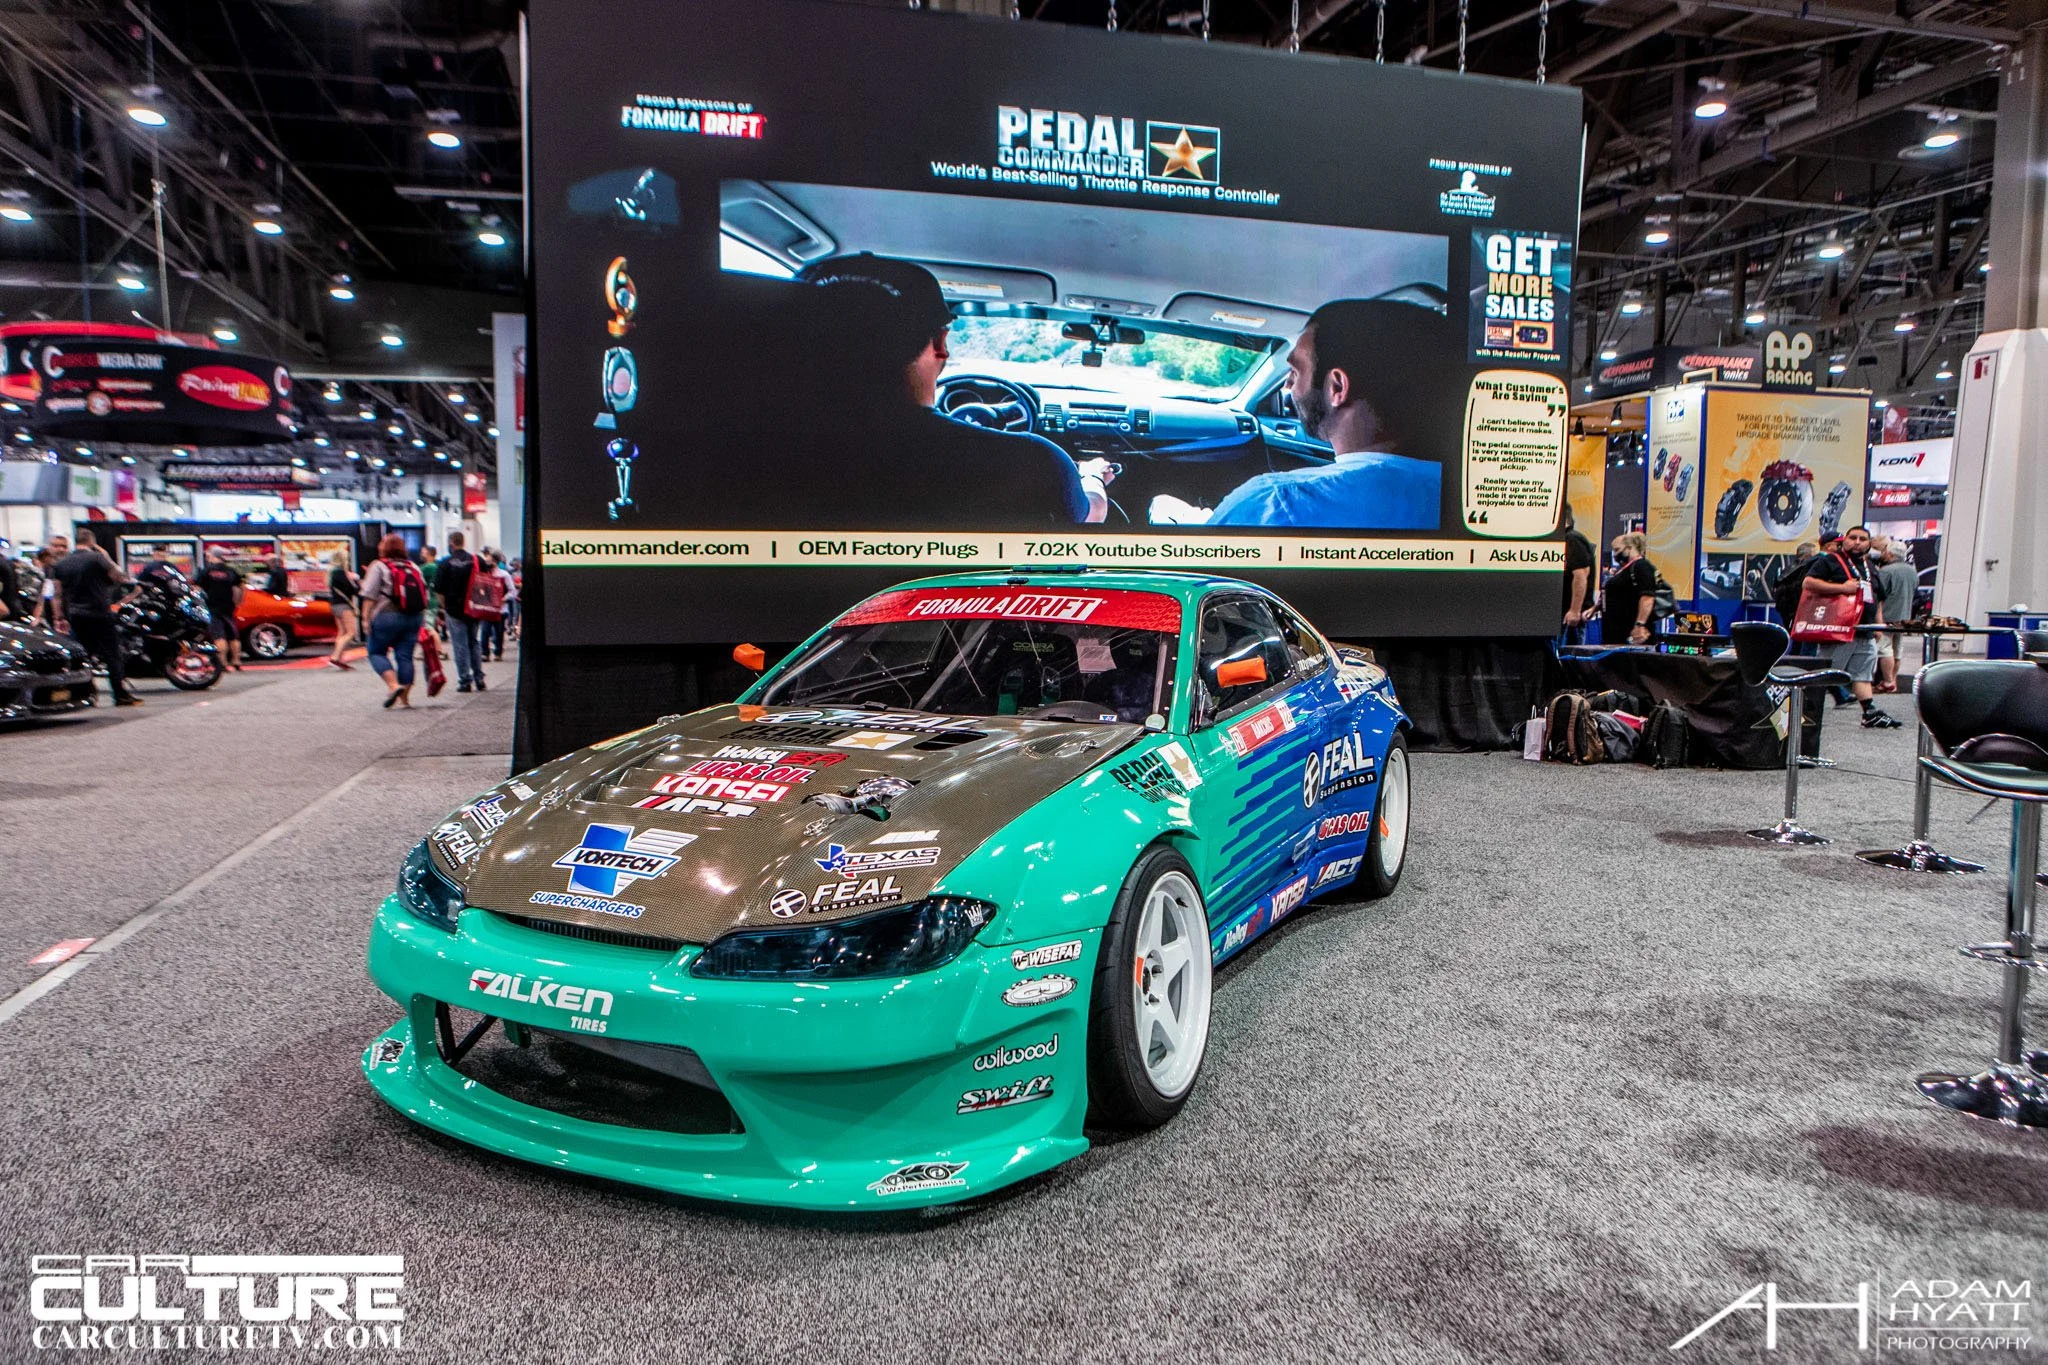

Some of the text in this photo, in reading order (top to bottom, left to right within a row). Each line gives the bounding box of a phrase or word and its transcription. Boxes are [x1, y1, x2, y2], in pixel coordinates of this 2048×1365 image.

[636, 94, 753, 113] PROUD SPONSORS OF
[621, 106, 760, 139] FORMULA DRIFT
[998, 105, 1144, 157] PEDAL
[998, 146, 1145, 180] COMMANDER
[1430, 158, 1456, 171] PROUD
[931, 161, 1280, 204] World's Best-Selling Throttle Response Controller
[1486, 234, 1558, 276] GET
[1488, 272, 1553, 297] MORE
[1485, 294, 1554, 321] SALES
[1476, 348, 1561, 362] with the Reseller Program
[1684, 355, 1754, 368] PERFORMANCE
[1603, 358, 1655, 377] PERFORMANCE
[1475, 381, 1564, 394] What Customer's
[1613, 371, 1651, 387] Electronics
[1766, 370, 1814, 386] RACING
[1492, 391, 1548, 403] Are Saying
[1476, 425, 1517, 433] difference
[1507, 418, 1536, 427] believe
[1737, 414, 1762, 422] TAKING
[1800, 416, 1818, 424] NEXT
[1820, 418, 1840, 426] LEVEL
[1472, 440, 1486, 448] The
[1488, 441, 1510, 450] pedal
[1736, 431, 1840, 442] UPGRADE BRAKING SYSTEMS
[1479, 456, 1500, 464] great
[1502, 456, 1533, 464] addition
[1500, 464, 1528, 472] pickup.
[1879, 456, 1917, 467] KONI
[1475, 485, 1508, 493] 4Runner
[1538, 486, 1552, 494] has
[1484, 478, 1544, 488] Really woke my
[1477, 492, 1499, 500] made
[1477, 499, 1514, 508] enjoyable
[799, 540, 846, 556] OEM
[852, 541, 917, 560] Factory
[927, 541, 979, 560] Plugs
[1026, 543, 1079, 557] 7.02K
[1085, 543, 1157, 558] Youtube
[1161, 543, 1261, 559] Subscribers
[1300, 546, 1357, 561] Instant
[1359, 547, 1454, 562] Acceleration
[1489, 549, 1517, 562] Ask
[1520, 550, 1538, 562] Us
[908, 597, 1099, 618] FORMULA DRIFT
[1806, 624, 1850, 633] SPYDER
[817, 711, 980, 731] FEAL
[711, 746, 790, 764] Holley
[1320, 732, 1374, 785] FEAL
[686, 760, 818, 784] LUCAS OIL
[1320, 774, 1374, 799] Suspension
[1347, 811, 1370, 833] OIL
[445, 830, 480, 864] FEAL
[844, 848, 940, 865] TEXAS
[573, 849, 662, 873] VORTECH
[1318, 855, 1363, 884] ACT
[811, 876, 901, 906] FEAL
[530, 891, 645, 918] SUPERCHARGERS
[813, 894, 899, 912] Suspension
[1029, 944, 1083, 966] WISEFAB
[469, 970, 614, 1016] FALKEN
[570, 1016, 607, 1034] TIRES
[973, 1034, 1059, 1072] wilwood
[958, 1075, 1054, 1106] Swift
